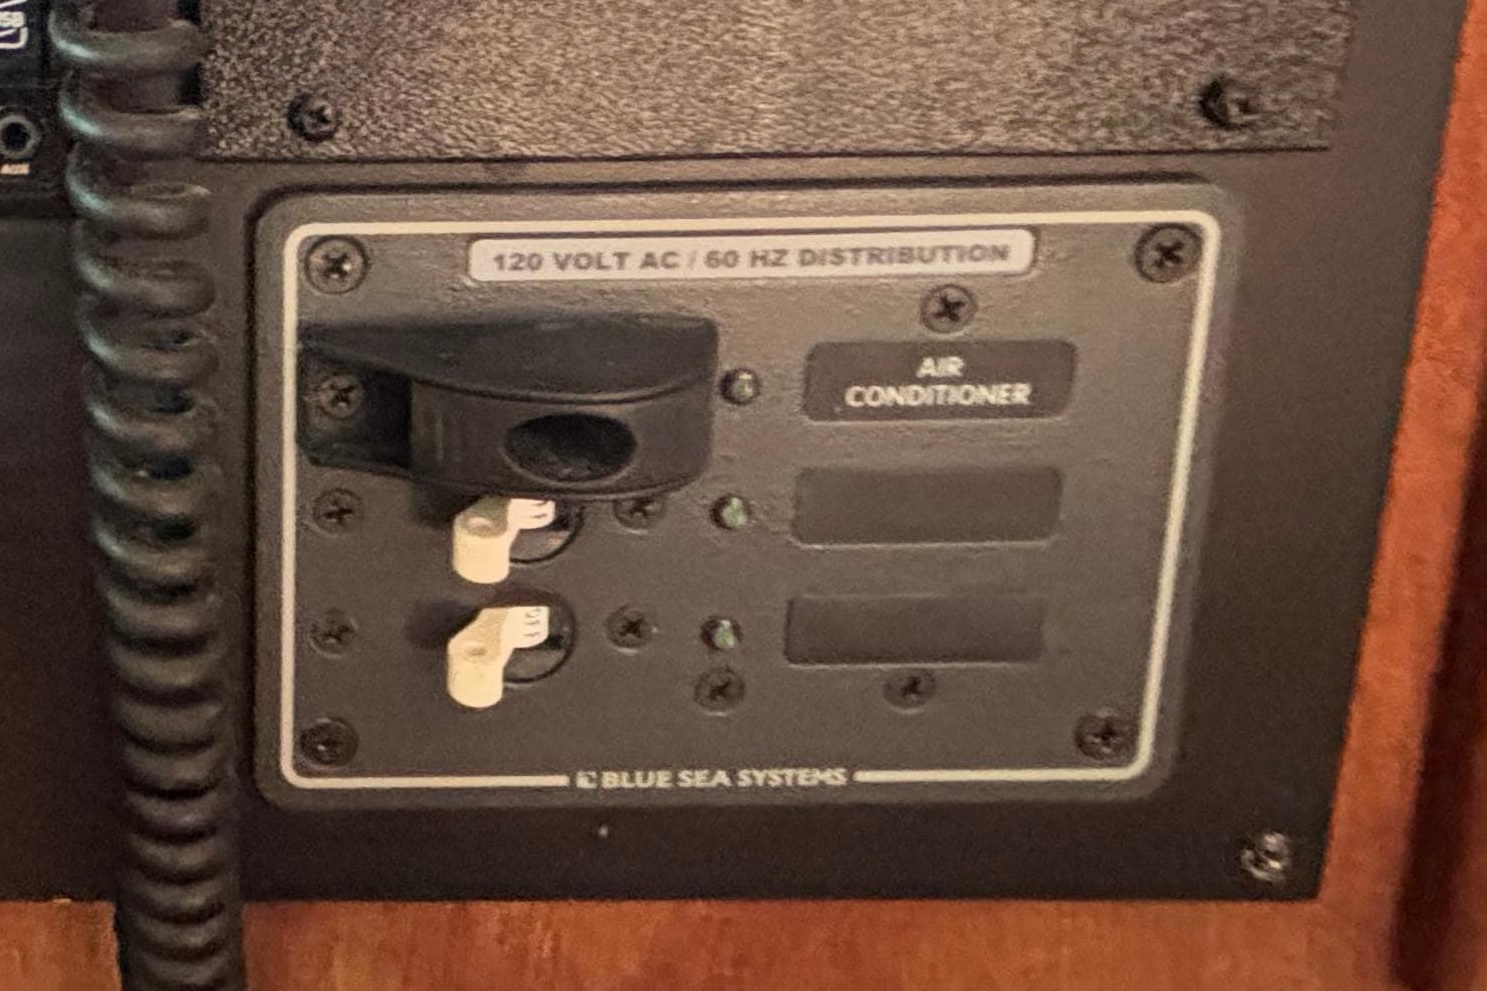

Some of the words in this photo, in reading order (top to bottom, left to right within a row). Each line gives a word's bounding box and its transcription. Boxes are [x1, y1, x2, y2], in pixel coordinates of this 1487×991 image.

[492, 252, 543, 272] 120
[552, 251, 631, 271] VOLT
[640, 250, 681, 269] AC
[703, 249, 740, 268] 60
[750, 248, 788, 268] HZ
[798, 244, 1012, 267] DISTRIBUTION
[916, 356, 965, 378] AIR
[844, 383, 1033, 408] CONDITIONER
[601, 771, 672, 790] BLUE
[677, 769, 732, 789] SEA
[736, 767, 848, 787] SYSTEMS
